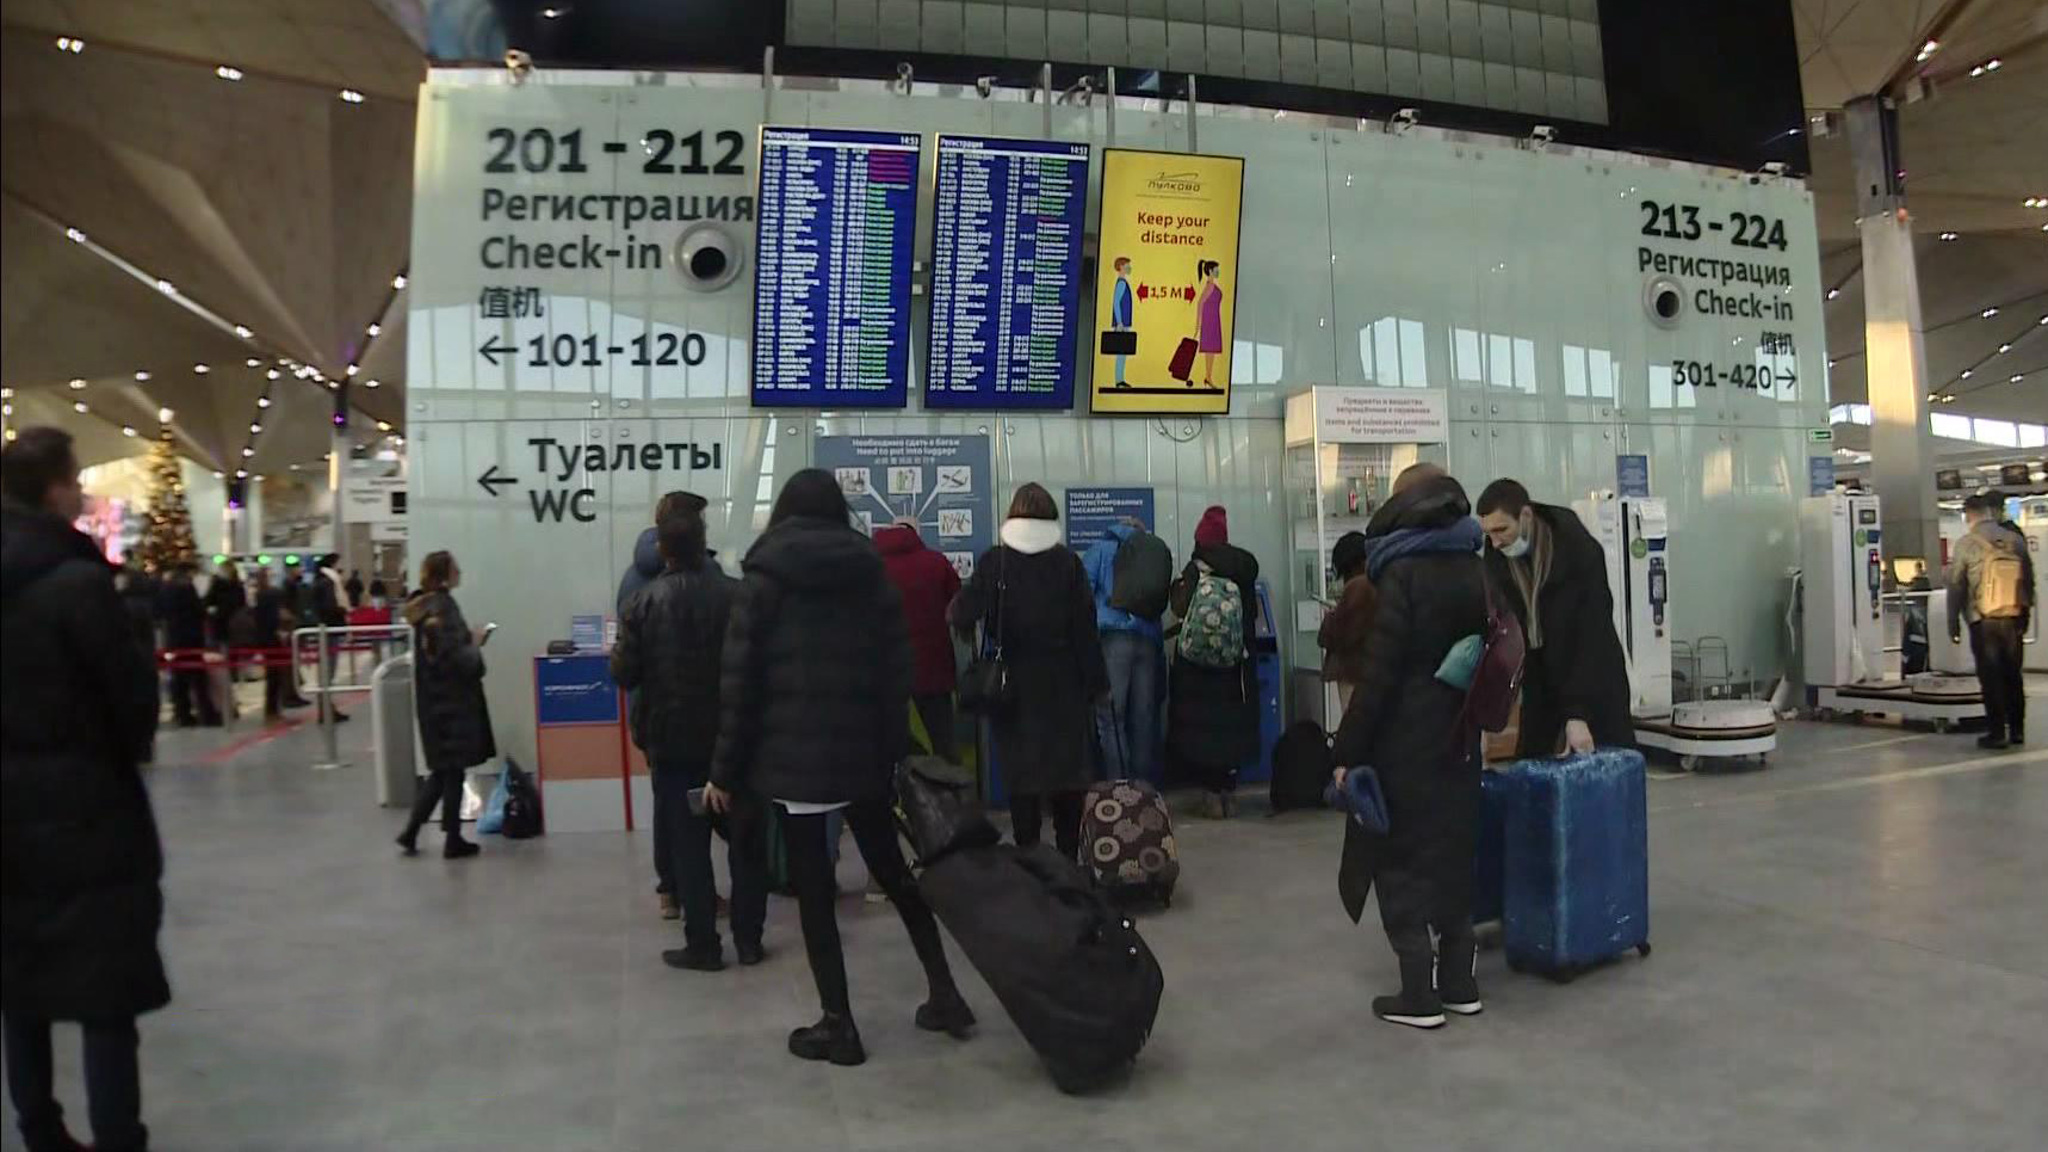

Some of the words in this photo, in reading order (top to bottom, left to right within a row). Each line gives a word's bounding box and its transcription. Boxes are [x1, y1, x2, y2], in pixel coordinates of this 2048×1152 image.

[485, 128, 587, 173] 201
[643, 129, 744, 175] 212
[483, 189, 754, 228] Регистрация
[1138, 212, 1173, 228] Keep
[1176, 216, 1210, 229] your
[1141, 230, 1204, 246] distance
[1641, 201, 1701, 240] 213
[1730, 212, 1787, 251] 224
[481, 235, 662, 270] Check-in
[1638, 247, 1790, 287] Регистрация
[479, 287, 544, 319] 值机
[1695, 289, 1793, 321] Check-in
[528, 332, 706, 367] 101-120
[1761, 331, 1796, 355] 值机
[1673, 360, 1772, 389] 301-420
[528, 437, 722, 482] Туалеты
[529, 489, 597, 522] WC
